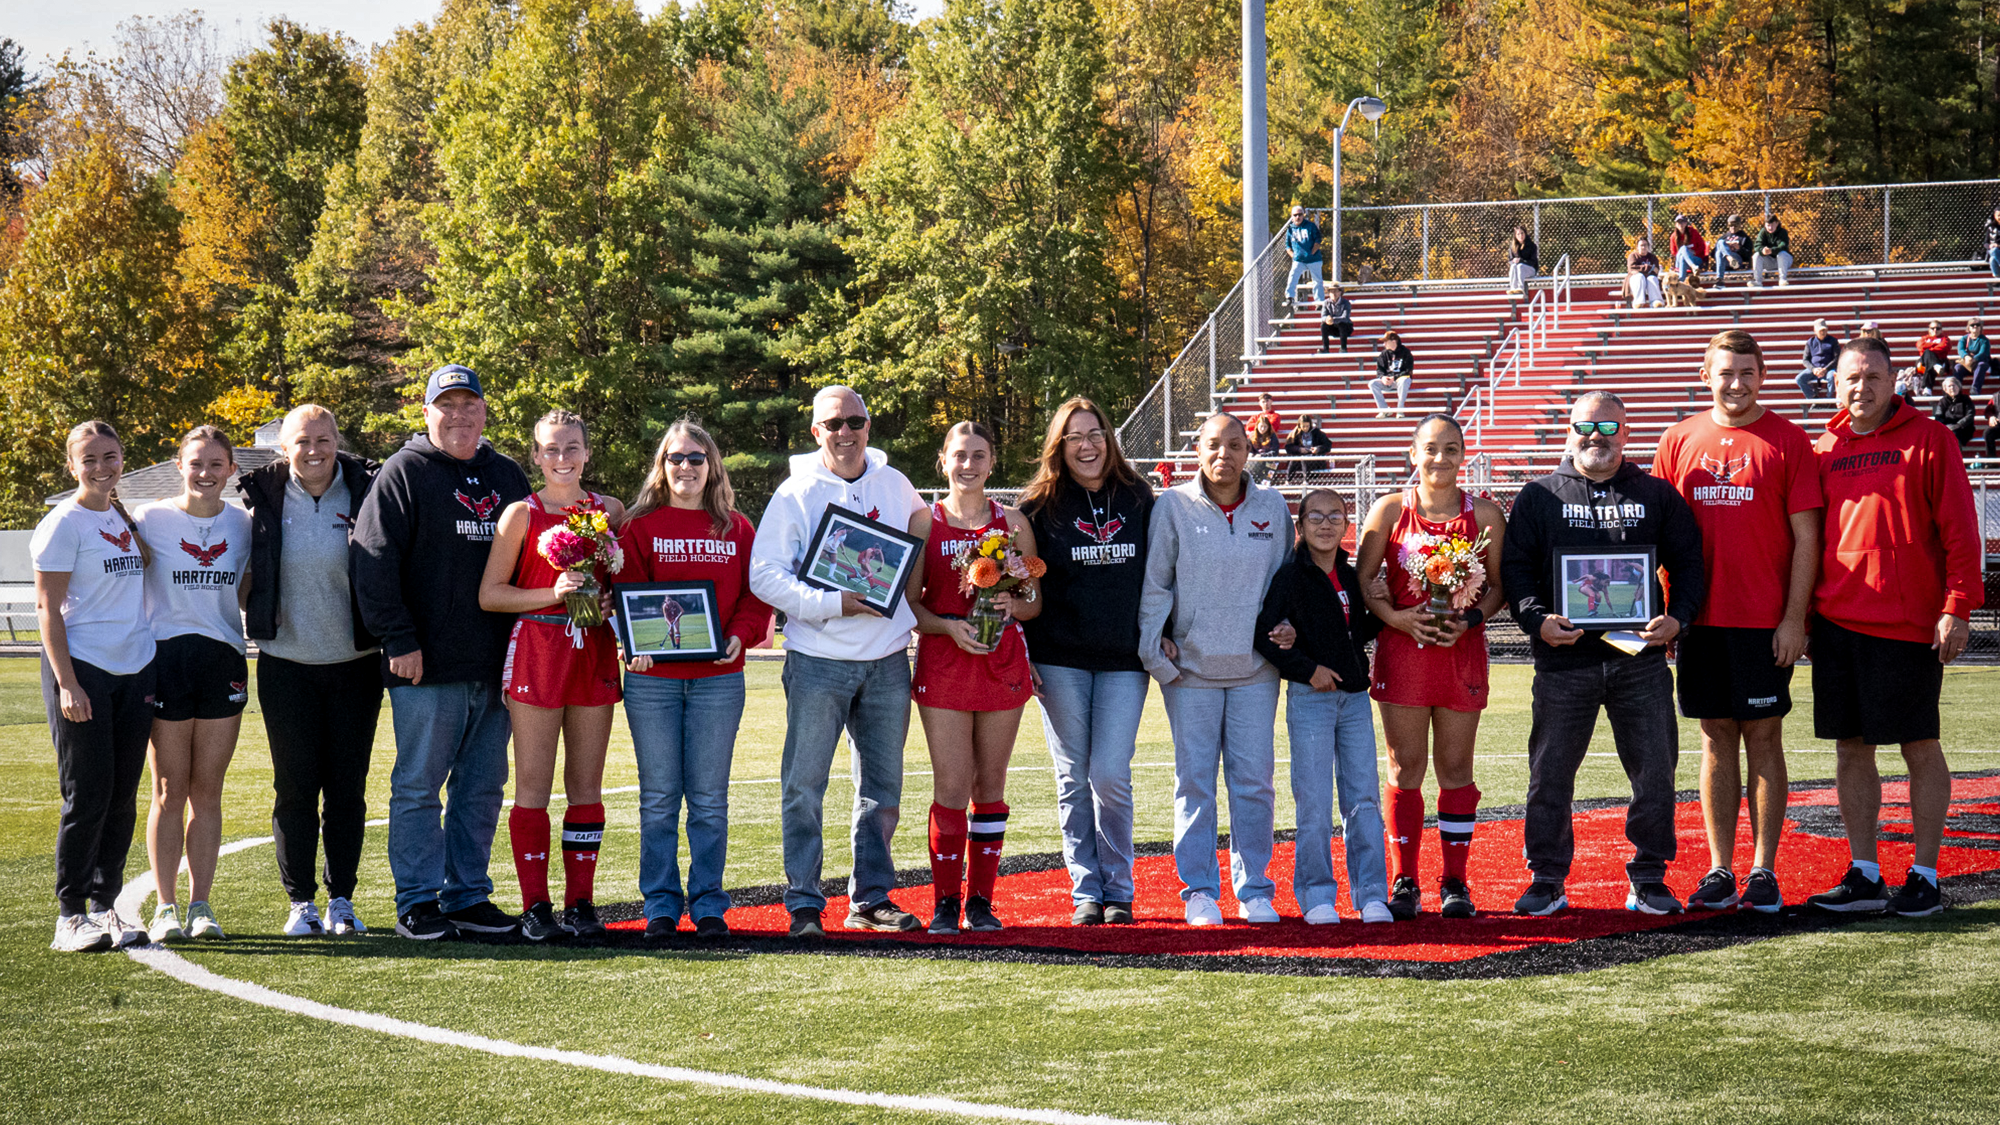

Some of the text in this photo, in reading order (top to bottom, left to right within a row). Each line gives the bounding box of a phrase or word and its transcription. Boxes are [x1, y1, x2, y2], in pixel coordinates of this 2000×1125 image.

[1830, 450, 1901, 472] HARTFORD
[1694, 485, 1755, 501] HARTFORD
[653, 536, 737, 556] HARTFORD
[1071, 543, 1136, 561] HARTFORD
[659, 554, 730, 564] FIELD HOCKEY
[172, 570, 236, 586] HARTFORD
[1748, 696, 1778, 705] HARTFORD
